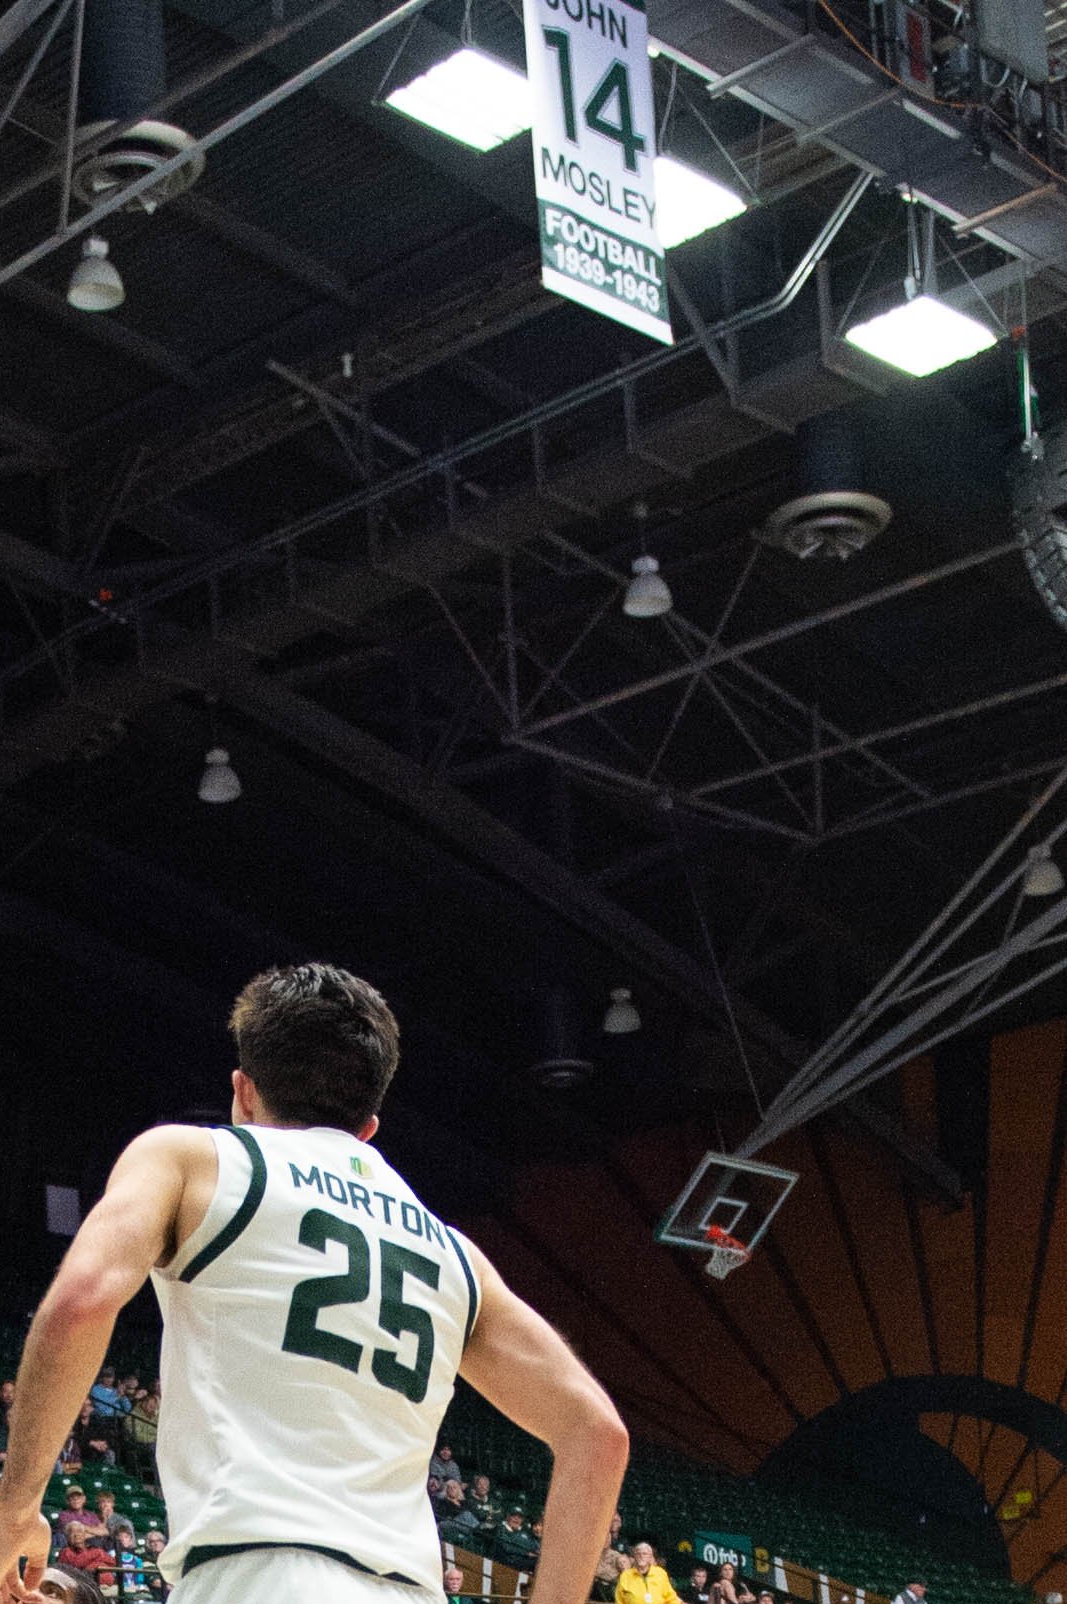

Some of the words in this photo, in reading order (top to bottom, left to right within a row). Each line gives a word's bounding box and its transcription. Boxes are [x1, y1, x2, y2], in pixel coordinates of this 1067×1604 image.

[545, 0, 628, 48] OHN
[541, 25, 647, 175] 14
[541, 147, 657, 229] MOSLEY
[545, 207, 662, 287] FOOTBALL
[553, 242, 660, 313] 1939-1943
[289, 1161, 448, 1250] MORTON
[282, 1208, 440, 1404] 25
